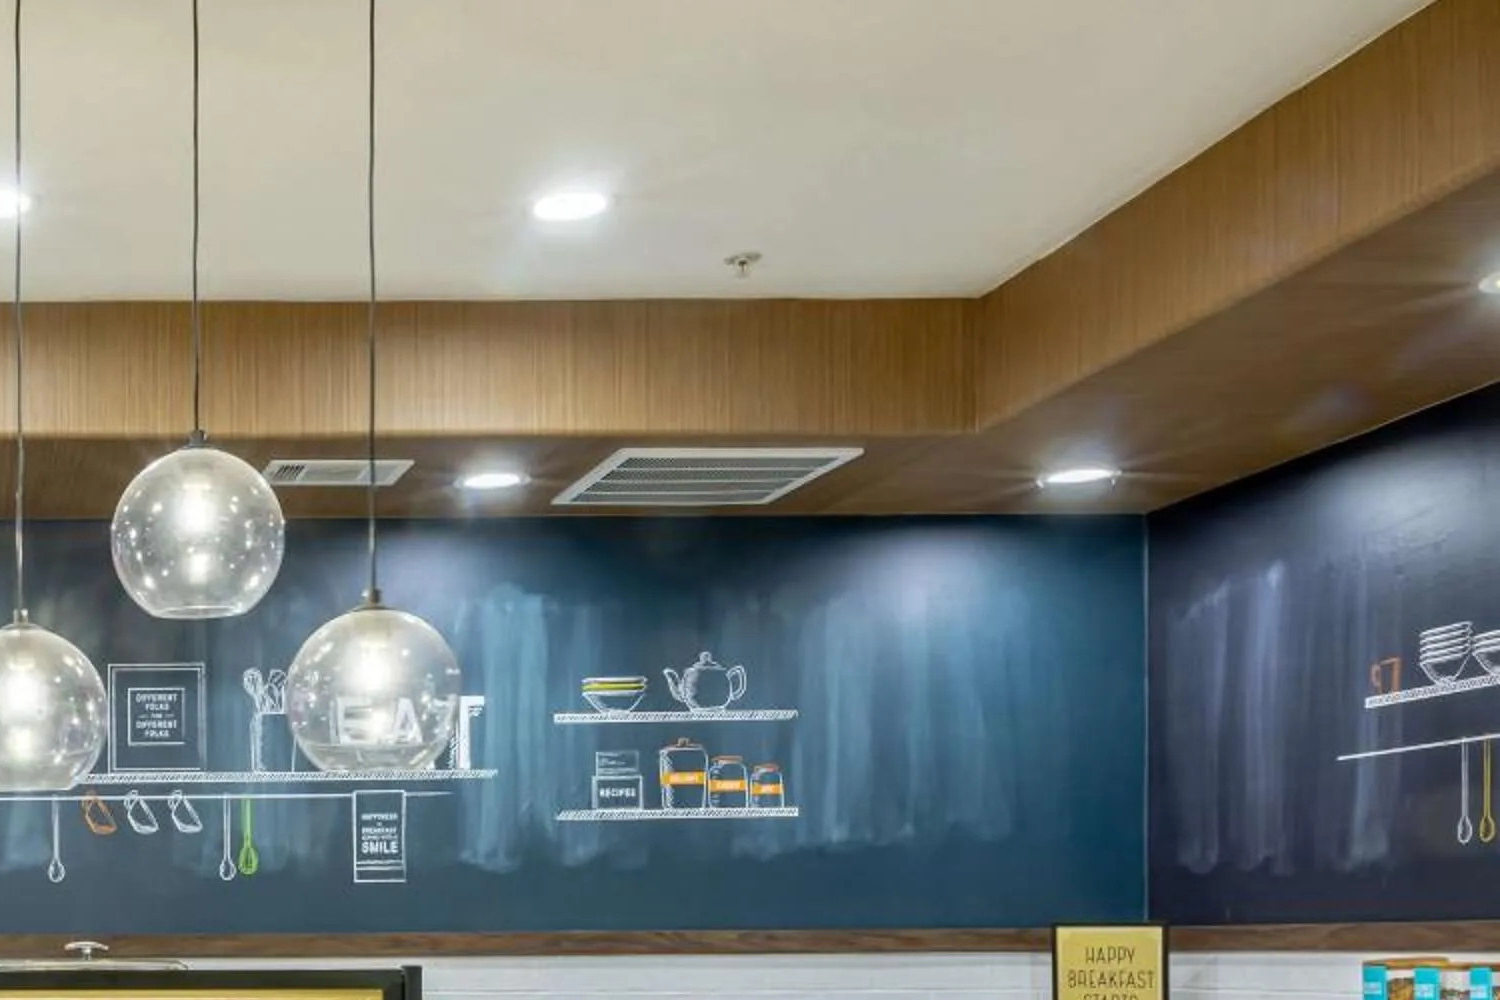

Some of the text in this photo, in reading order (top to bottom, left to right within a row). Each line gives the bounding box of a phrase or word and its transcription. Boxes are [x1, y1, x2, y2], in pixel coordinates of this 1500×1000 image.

[361, 841, 399, 854] SMILE
[1085, 946, 1136, 964] HAPPY
[1066, 968, 1156, 989] BREAKFAST
